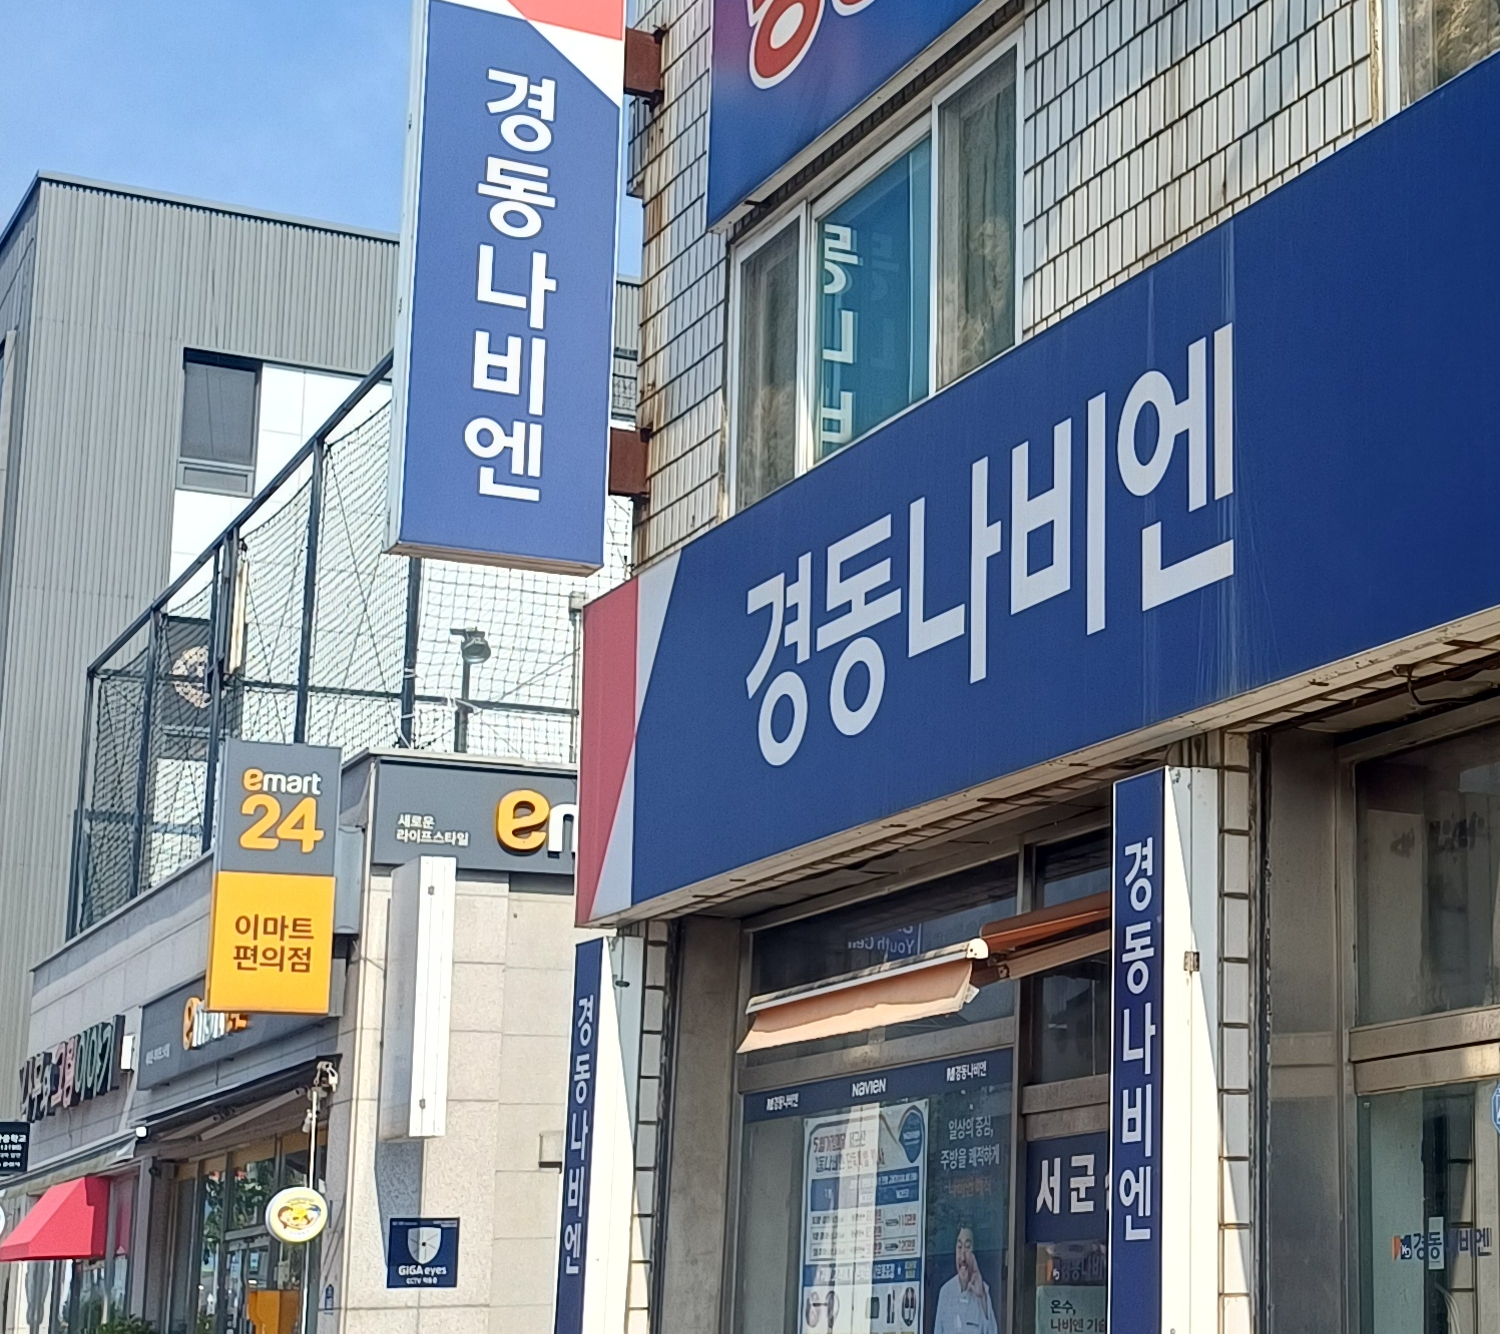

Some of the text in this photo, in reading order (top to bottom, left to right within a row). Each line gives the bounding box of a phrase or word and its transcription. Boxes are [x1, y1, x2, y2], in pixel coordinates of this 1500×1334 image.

[463, 67, 559, 504] 경동나비엔
[745, 322, 1234, 766] 경동나비엔
[243, 768, 323, 796] emart
[239, 793, 325, 854] 24
[397, 813, 435, 829] 새로운
[396, 828, 469, 847] 라이프스타일
[234, 913, 315, 942] 이마트
[233, 944, 312, 973] 편의점
[1119, 836, 1157, 1242] 경동나비엔
[564, 994, 594, 1274] 경동나비엔
[949, 1118, 973, 1140] 일상의
[940, 1148, 967, 1170] 주방을
[1036, 1154, 1109, 1215] 서군
[1413, 1227, 1492, 1260] 경동비엔
[398, 1264, 447, 1277] GIGA eyes
[1051, 1299, 1076, 1315] 온수,
[1051, 1317, 1084, 1333] 나비엔
